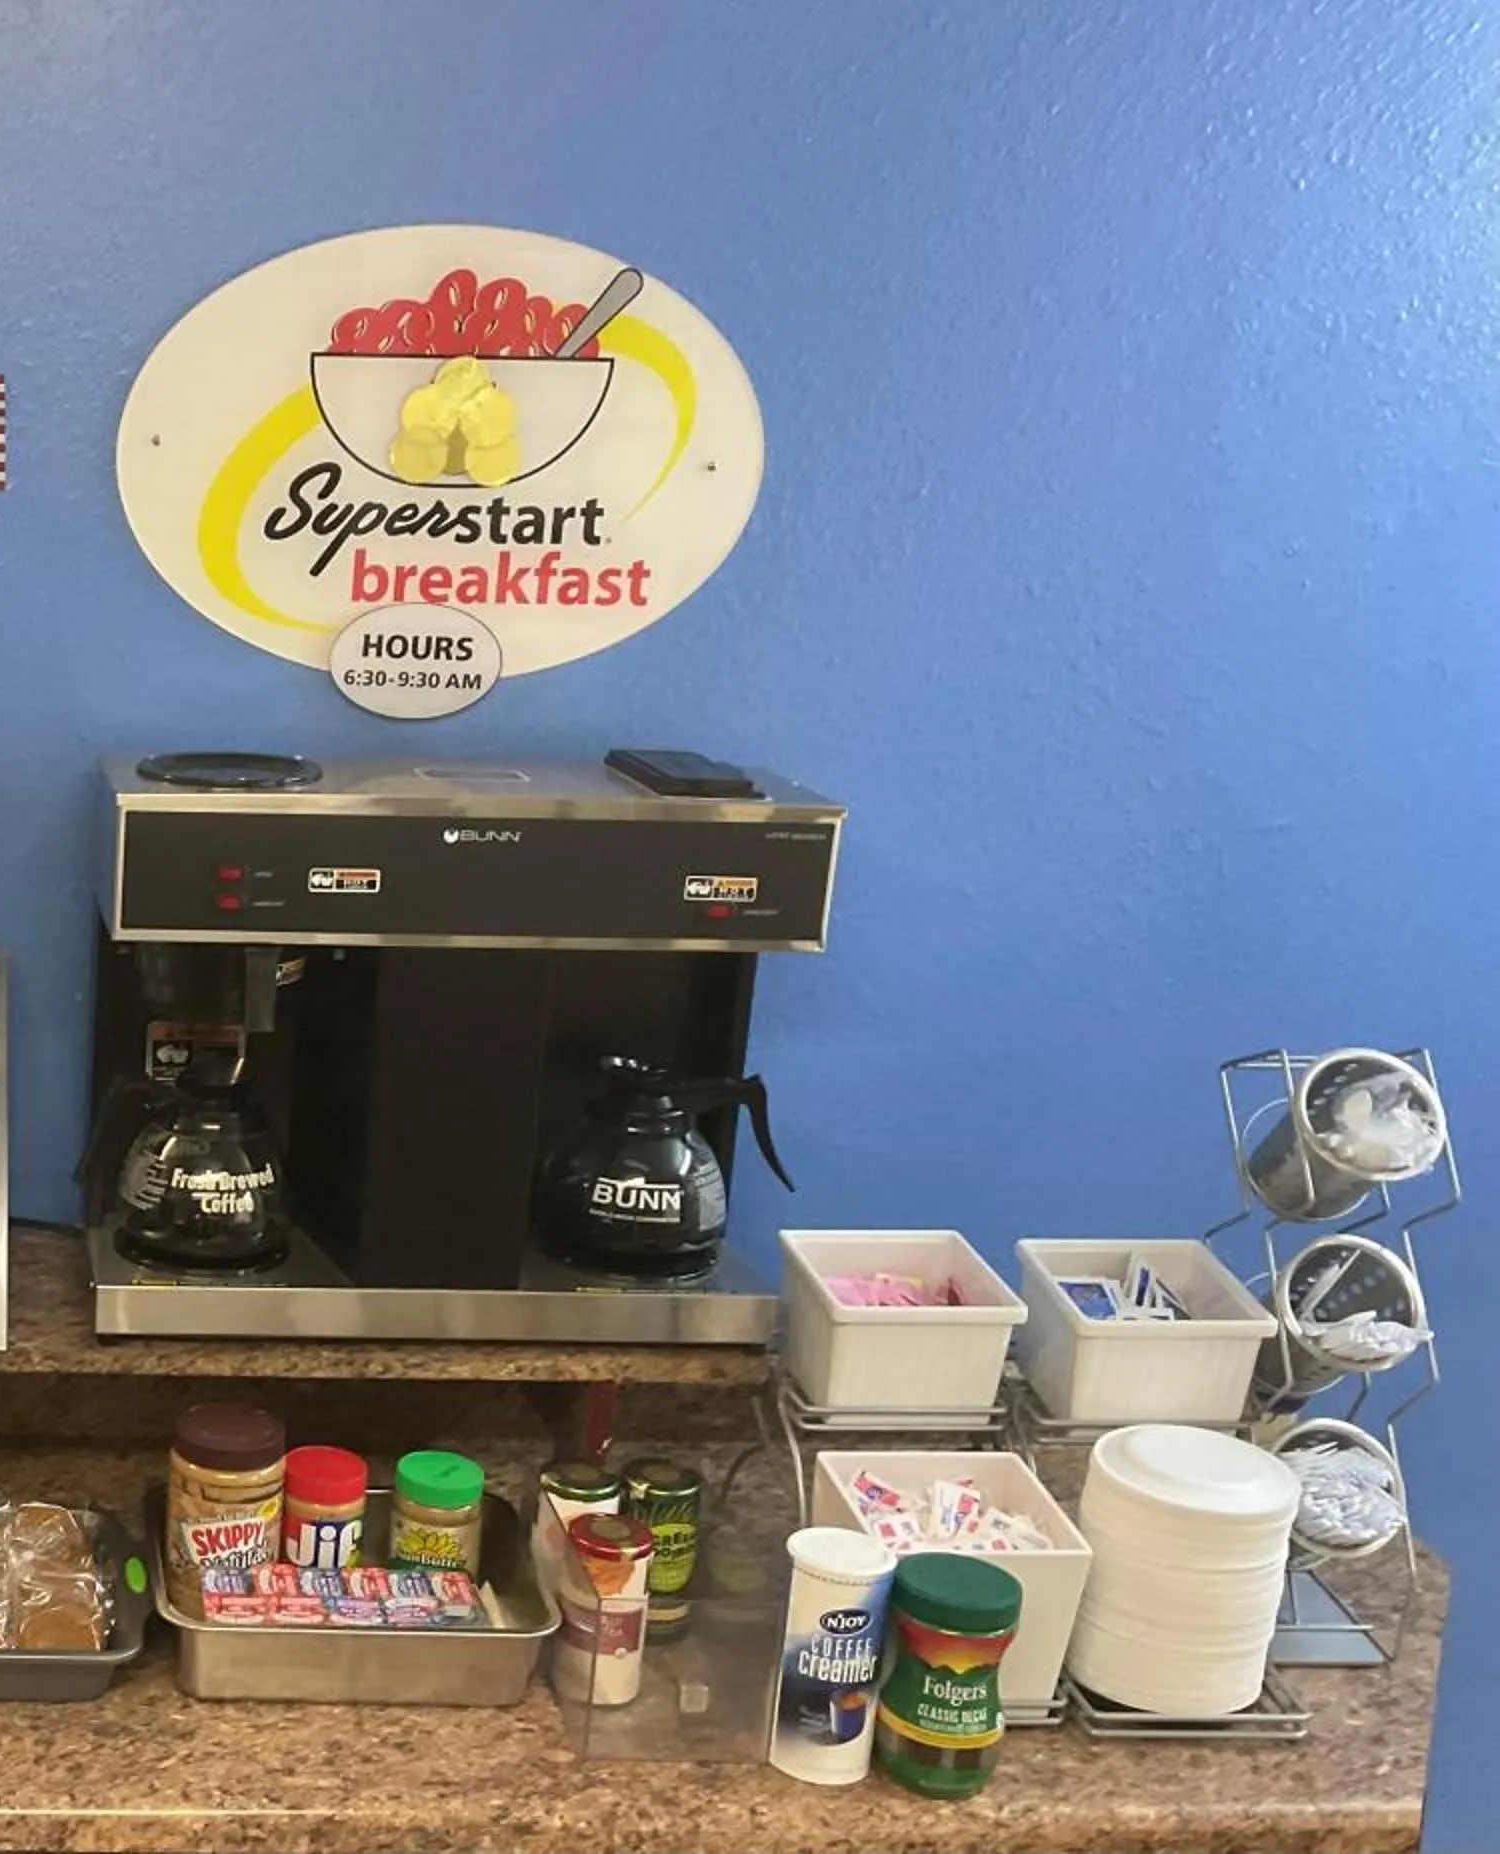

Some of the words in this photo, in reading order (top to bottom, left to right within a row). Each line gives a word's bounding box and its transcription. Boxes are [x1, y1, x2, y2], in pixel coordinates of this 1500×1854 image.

[263, 461, 605, 577] Superstart
[350, 548, 651, 607] breakfast
[361, 633, 474, 662] HOURS
[343, 669, 440, 690] 6:30-9:30
[444, 672, 482, 691] AM
[460, 828, 522, 843] BUNN
[591, 1177, 684, 1211] BUNN
[191, 1520, 266, 1557] SKIPPY
[285, 1518, 363, 1569] Jif
[810, 1634, 873, 1659] COFFEE
[798, 1650, 878, 1684] Creamer
[922, 1675, 988, 1707] Folgers
